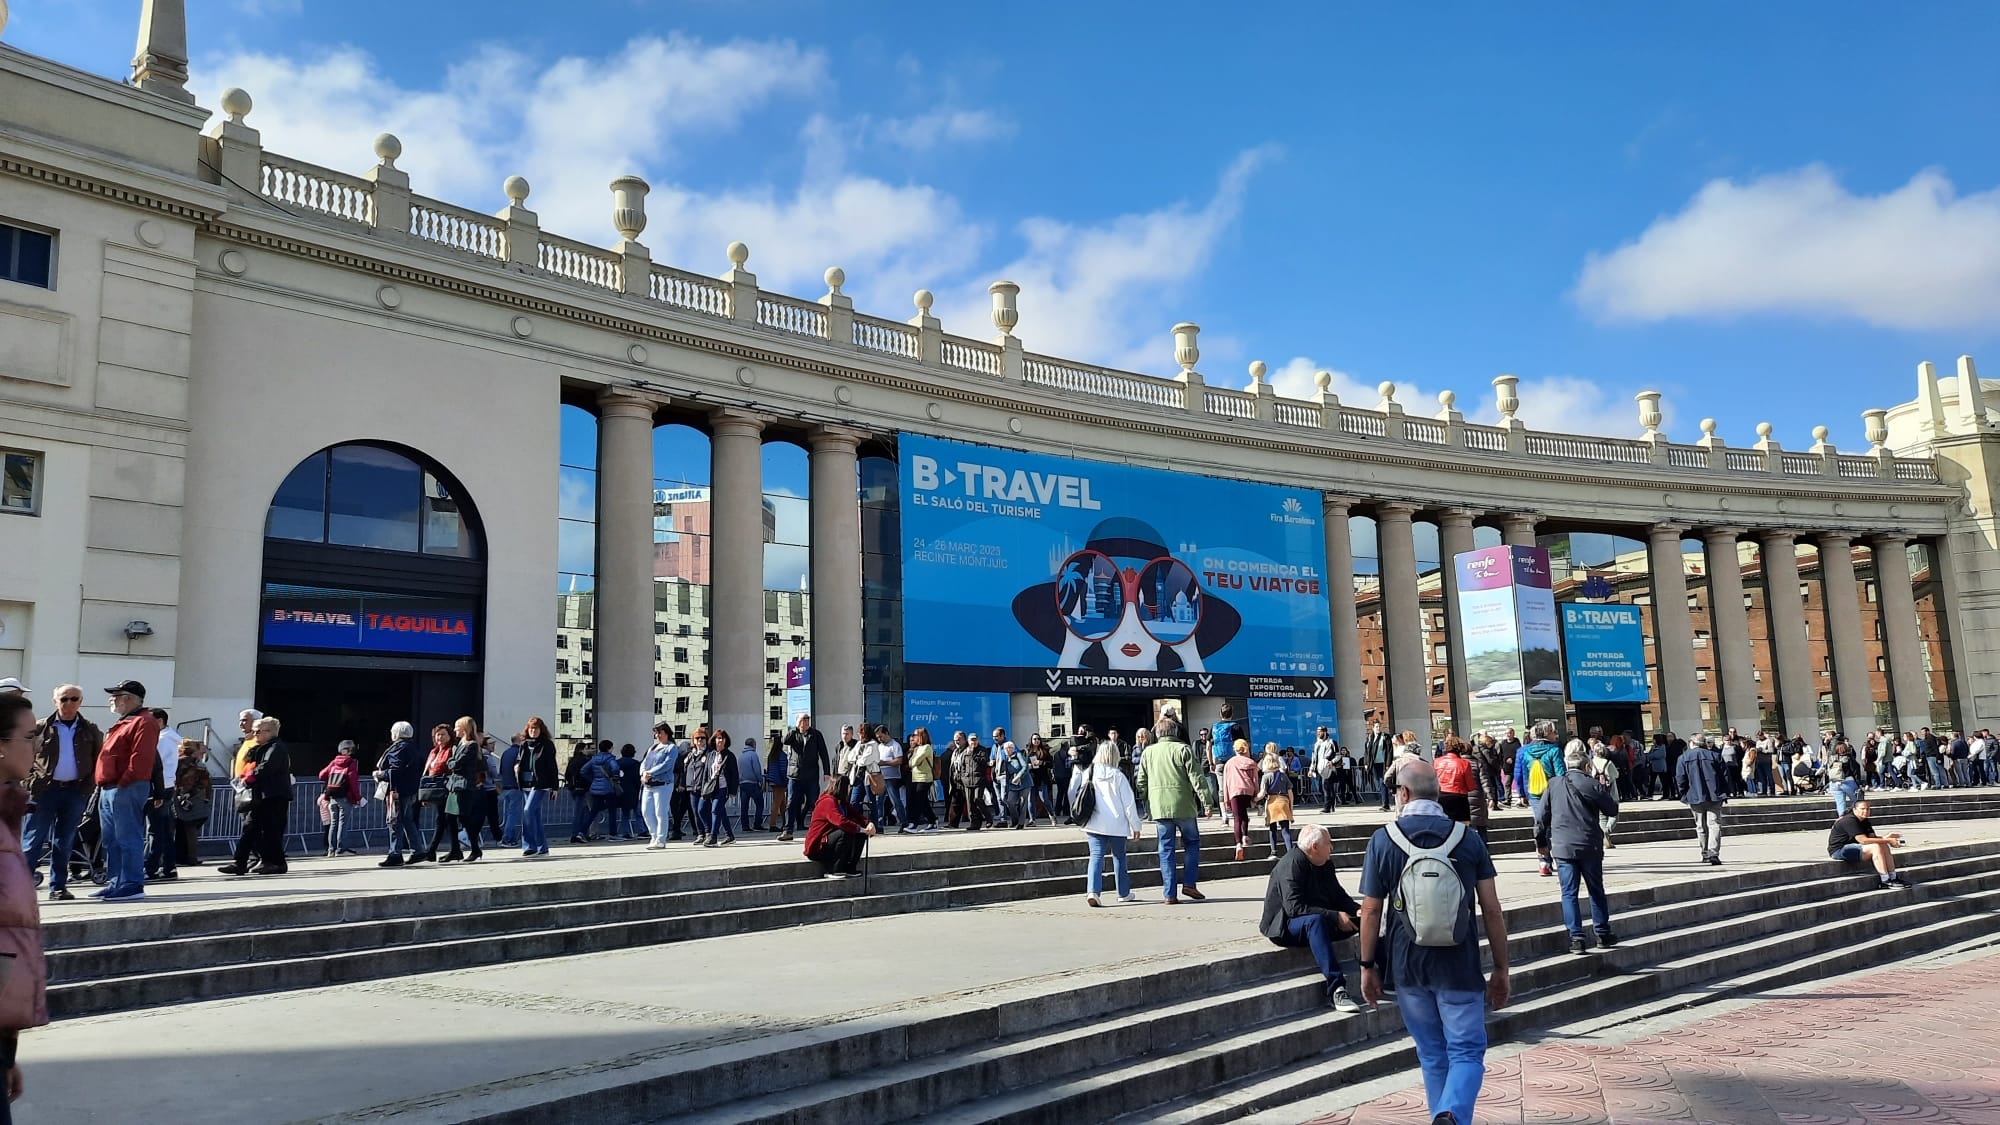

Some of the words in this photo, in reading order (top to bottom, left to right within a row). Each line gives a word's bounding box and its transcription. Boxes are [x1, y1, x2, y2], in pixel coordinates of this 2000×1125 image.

[913, 493, 928, 506] EL
[931, 496, 963, 510] SALÓ
[966, 500, 989, 513] DEL
[991, 503, 1041, 519] TURISME
[1270, 513, 1283, 522] Fira
[1284, 514, 1315, 526] Barcelona
[913, 537, 925, 549] 24
[914, 550, 957, 564] RECINTE
[1466, 556, 1496, 570] renfe
[1203, 558, 1224, 569] ON
[1228, 559, 1298, 576] COMENÇA
[1301, 566, 1318, 577] EL
[1203, 571, 1243, 590] TEU
[1248, 575, 1320, 595] VIATGE
[367, 613, 468, 635] TAQUILLA
[1066, 675, 1126, 687] ENTRADA
[1129, 677, 1195, 689] VISITANTS
[910, 698, 936, 706] Platinum
[937, 699, 961, 707] Partners
[910, 711, 939, 724] renfe
